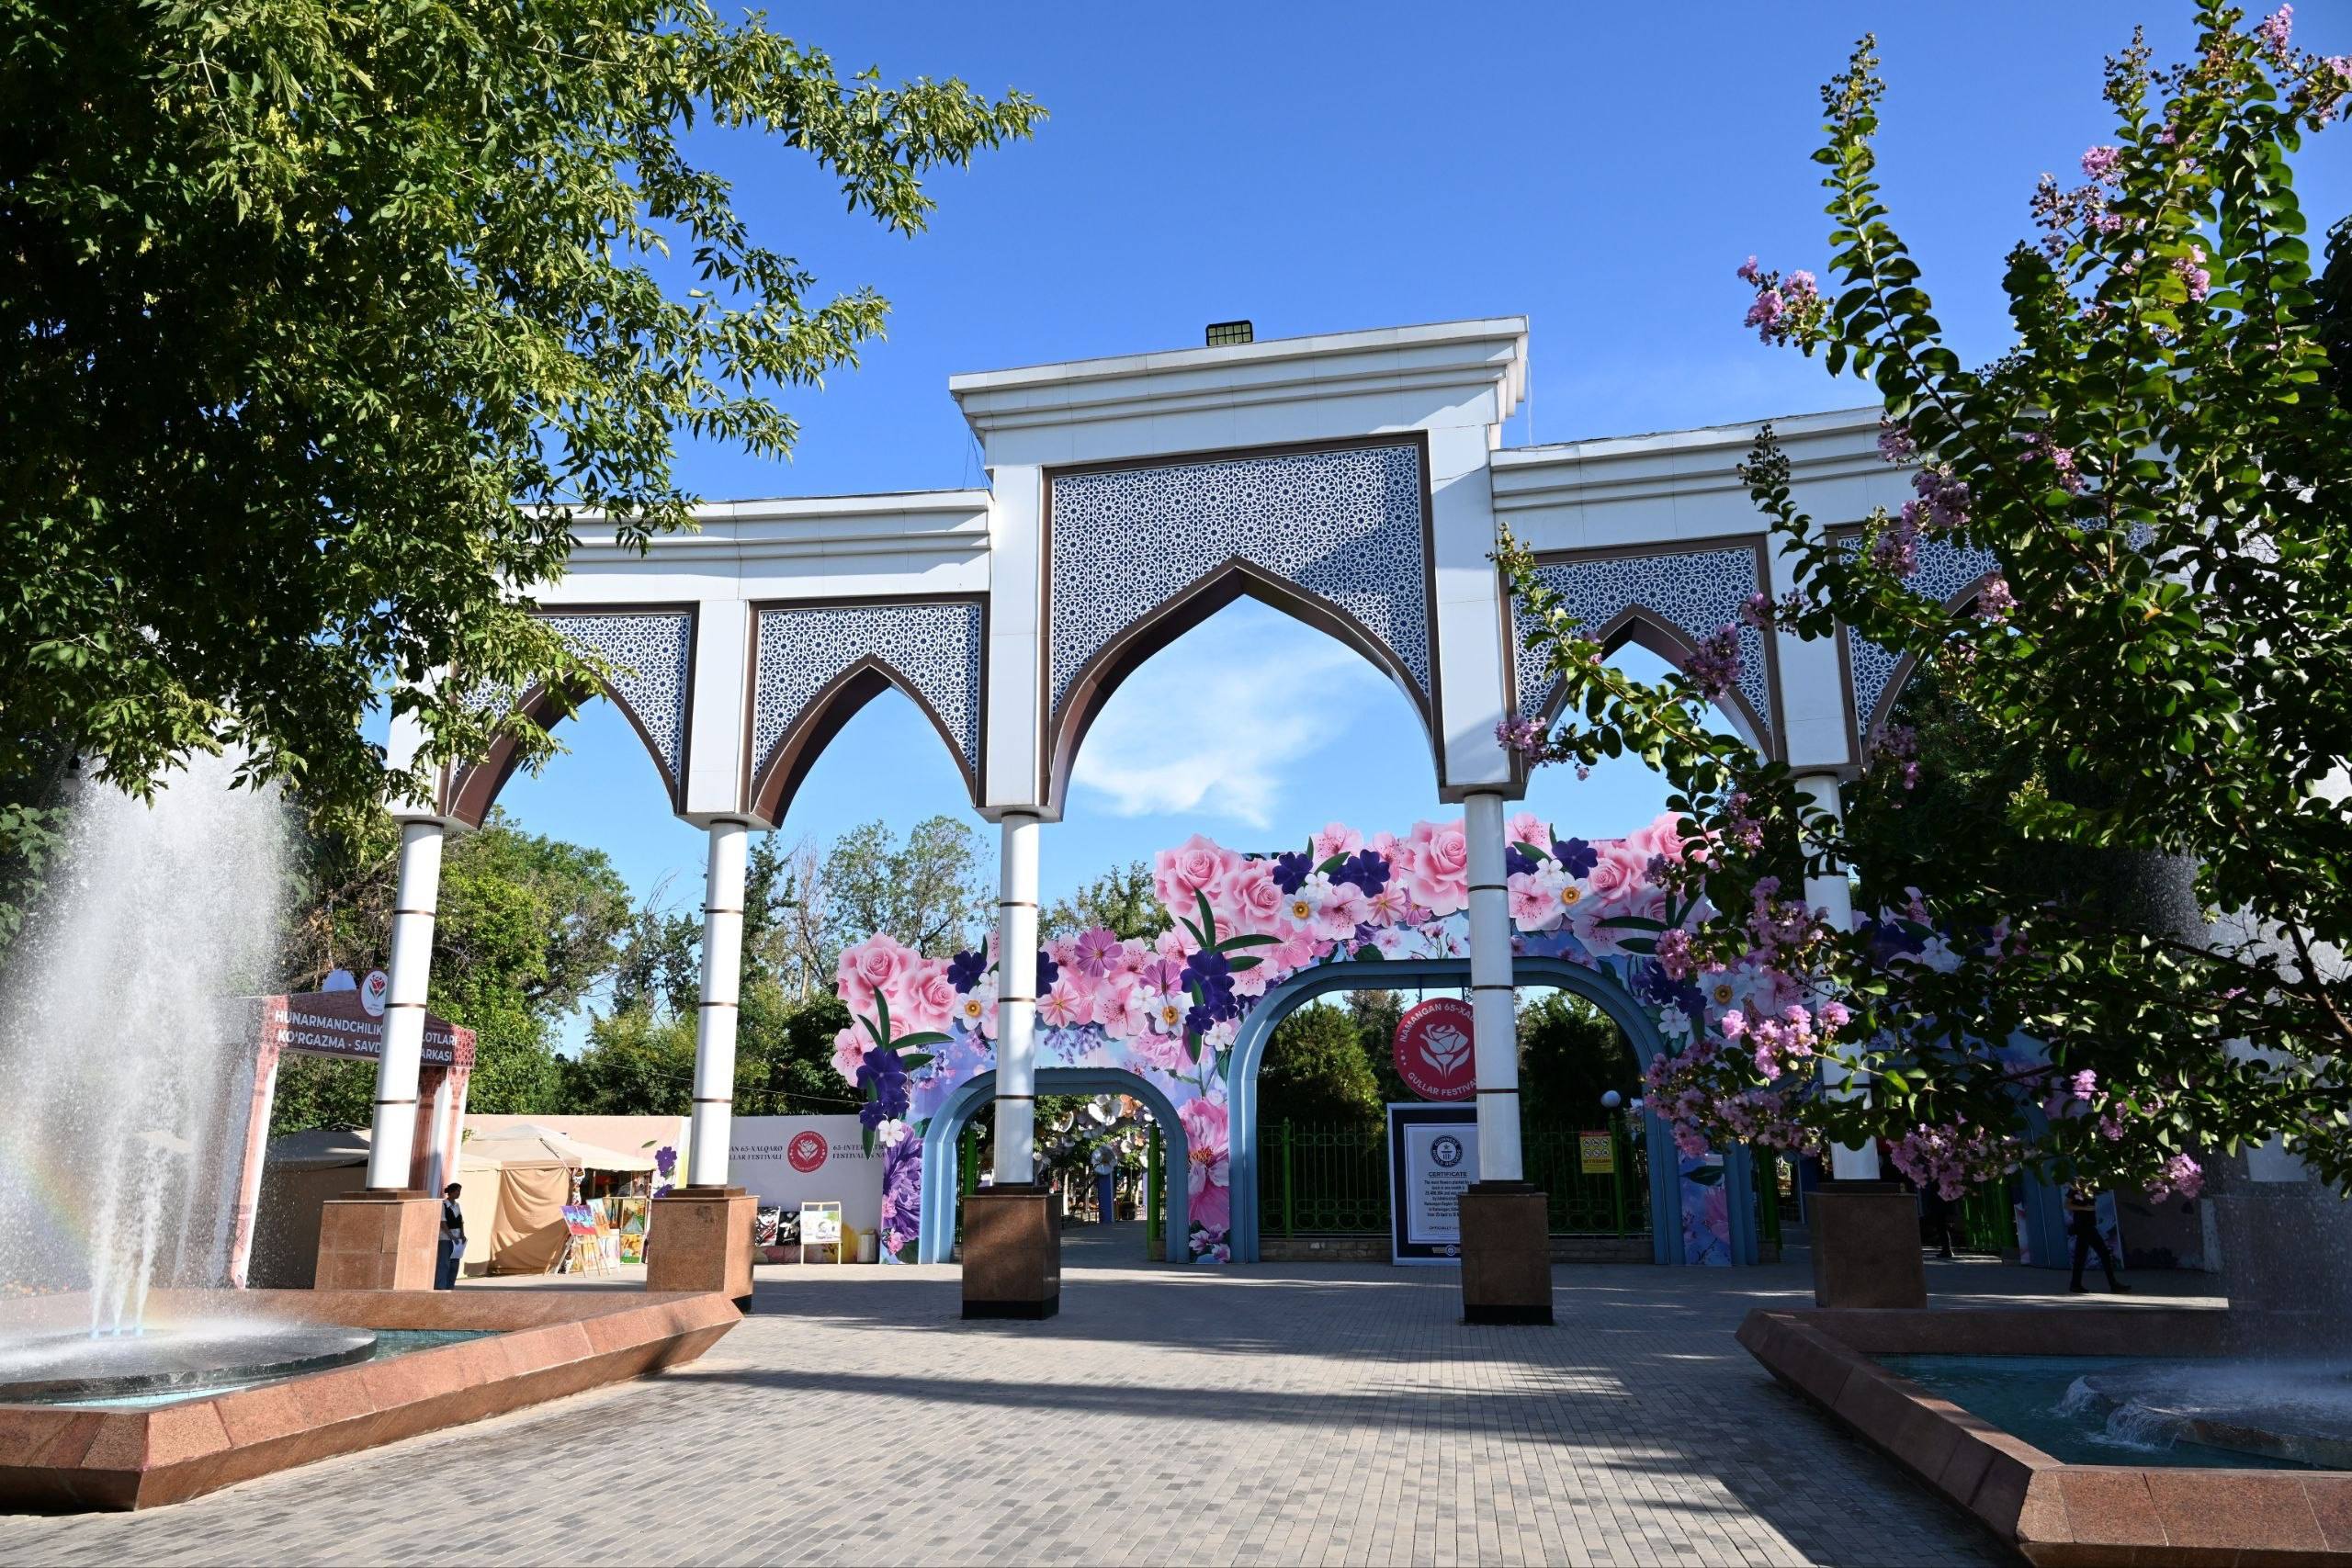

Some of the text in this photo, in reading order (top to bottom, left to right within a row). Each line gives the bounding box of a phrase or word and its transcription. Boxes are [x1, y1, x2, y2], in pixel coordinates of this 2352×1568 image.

[275, 1010, 458, 1046] HUNARMANDCHILIK OTLARI
[1399, 1003, 1475, 1043] NAMANGAN 65-XAL
[354, 1039, 382, 1054] SAVD
[421, 1048, 453, 1062] ARKASI
[1408, 1072, 1477, 1096] GULLAR FESTIVA
